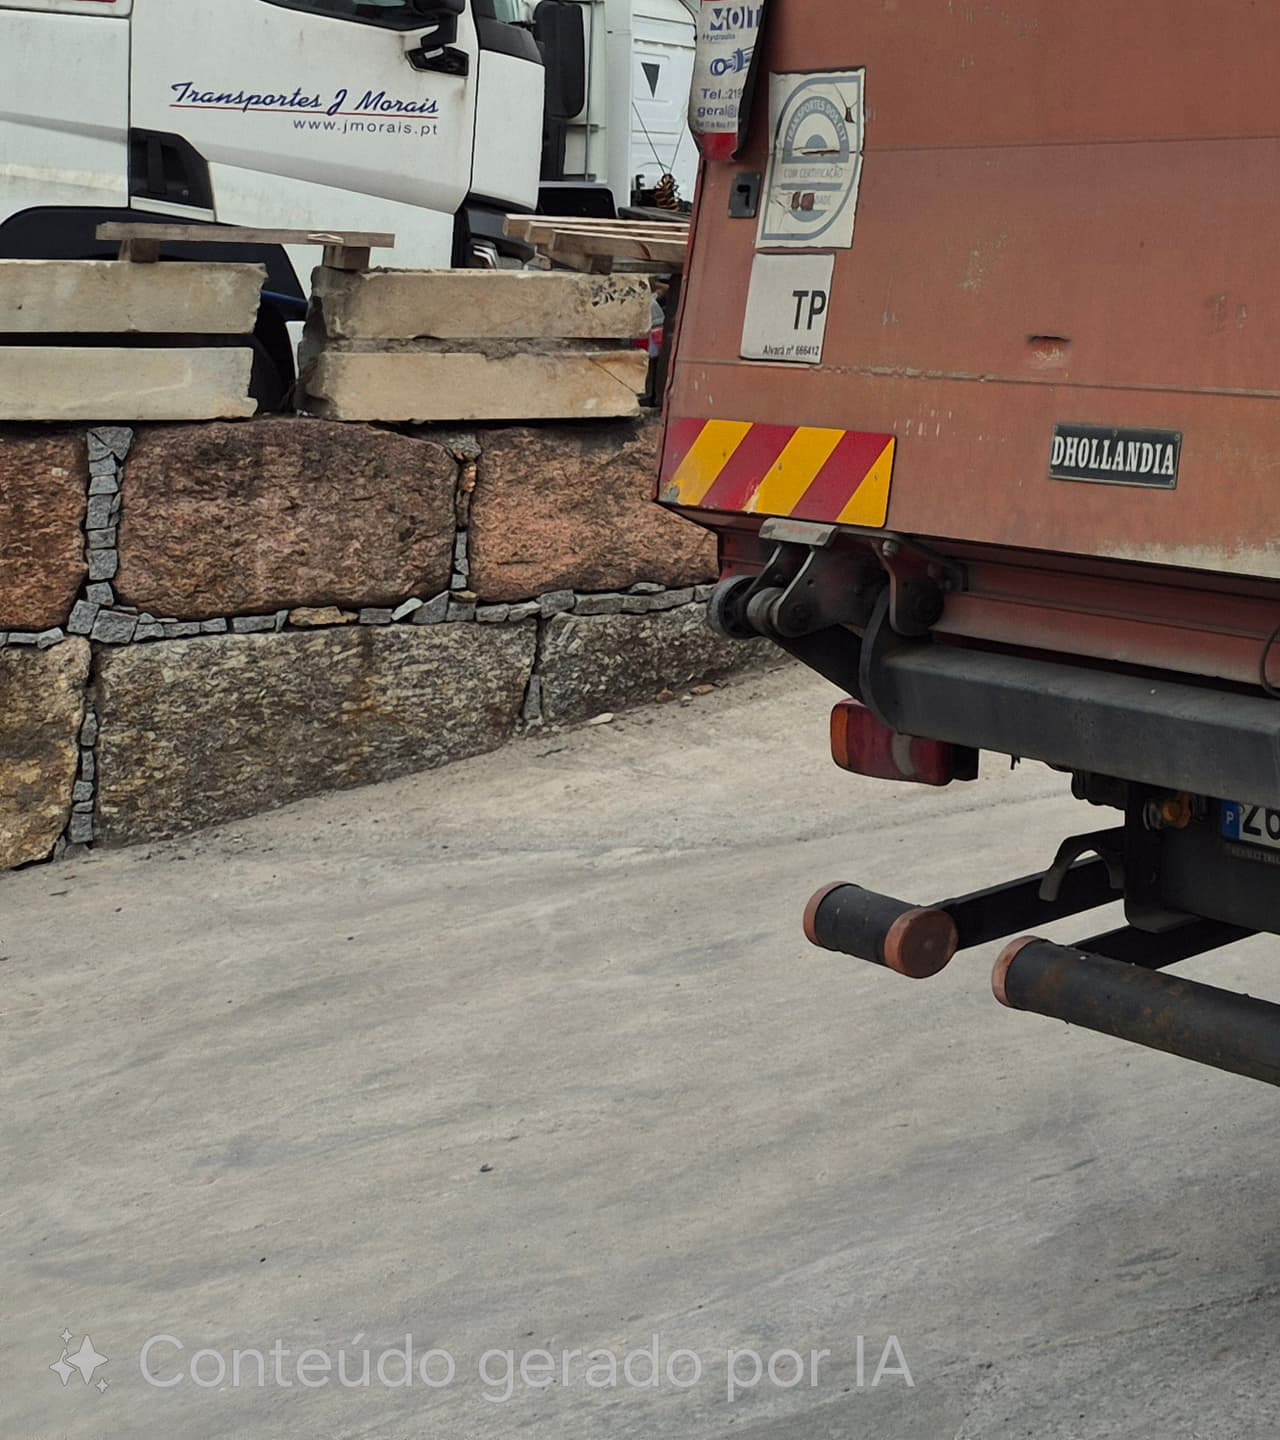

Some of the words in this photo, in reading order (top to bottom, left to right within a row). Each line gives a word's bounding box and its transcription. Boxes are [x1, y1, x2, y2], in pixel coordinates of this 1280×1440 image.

[170, 81, 322, 113] Transportes
[326, 89, 348, 116] J
[354, 90, 439, 114] Morais
[293, 120, 438, 136] www.jmorais.pt
[792, 290, 827, 330] TP
[1051, 436, 1174, 475] DHOLLANDIA
[1226, 811, 1235, 824] P
